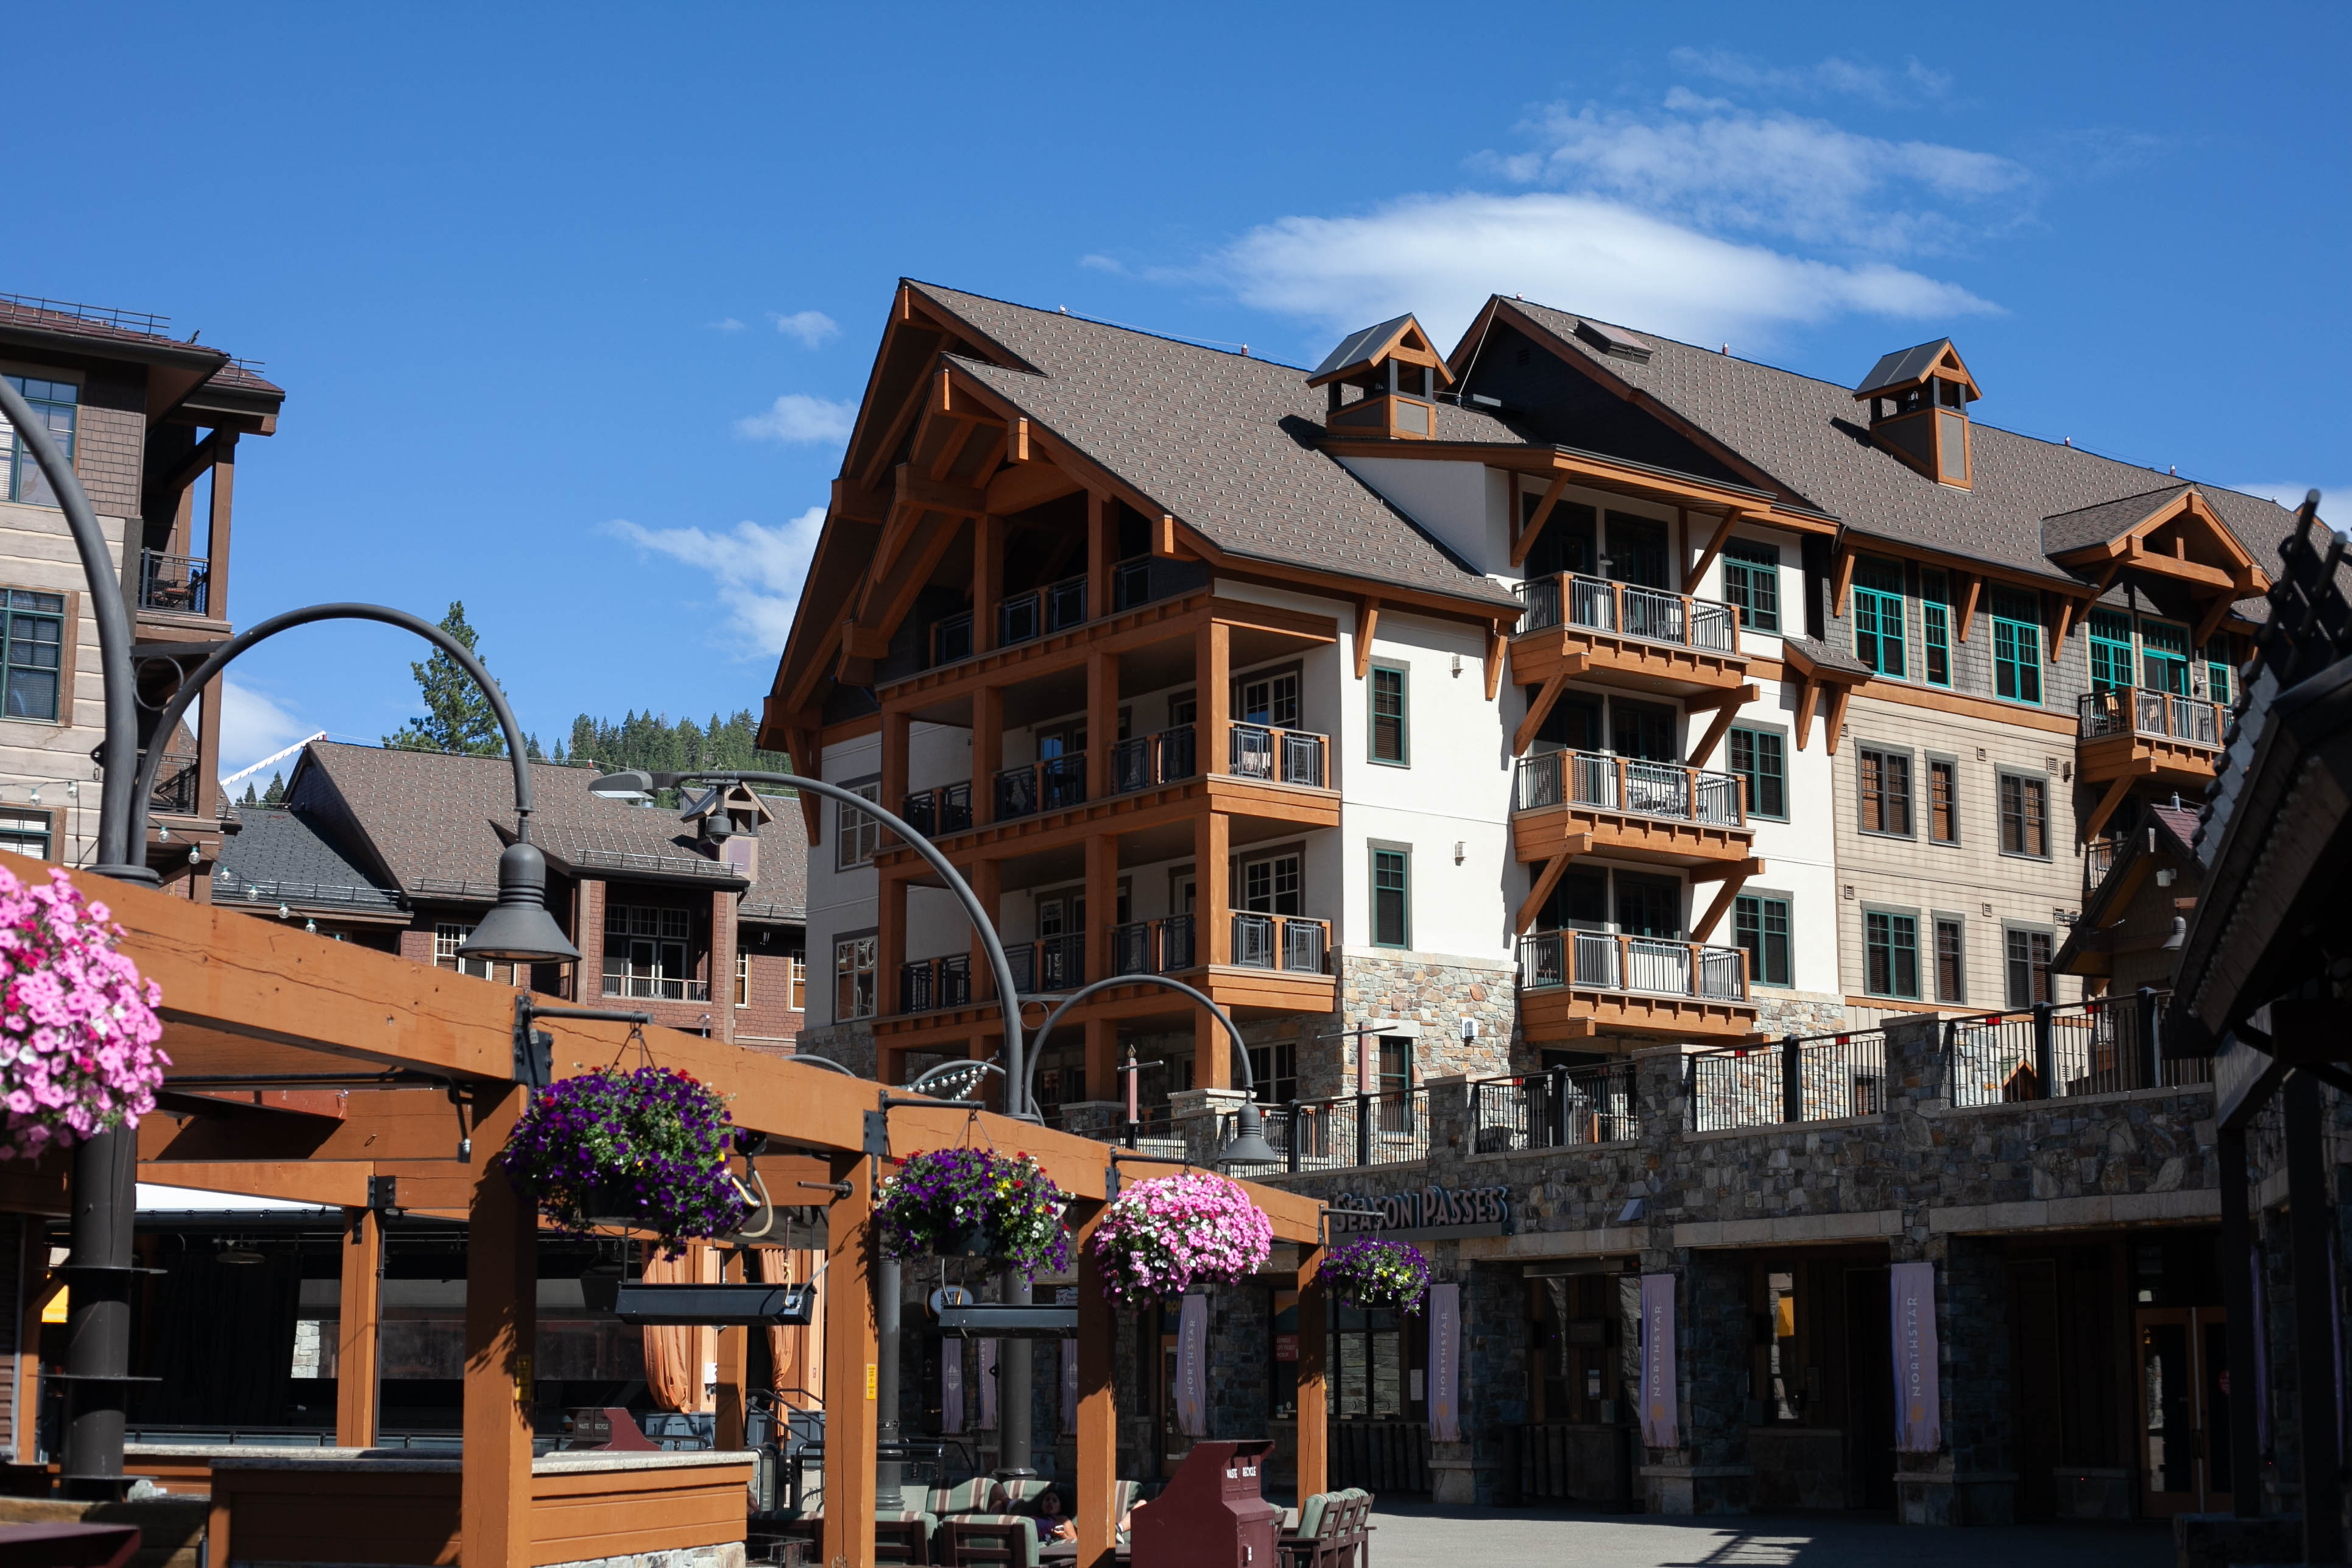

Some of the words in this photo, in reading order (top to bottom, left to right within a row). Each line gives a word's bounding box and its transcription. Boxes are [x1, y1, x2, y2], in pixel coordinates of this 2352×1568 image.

[1333, 1193, 1415, 1233] SEASON
[1421, 1187, 1505, 1227] PASSES
[1187, 1319, 1196, 1395] NORTHSTAR
[1439, 1312, 1448, 1396] NORTHSTAR
[1653, 1305, 1662, 1397] NORTHSTAR
[1907, 1296, 1922, 1397] NORTHSTAR
[1226, 1468, 1238, 1479] WASTE
[1242, 1466, 1257, 1477] RECYCLE
